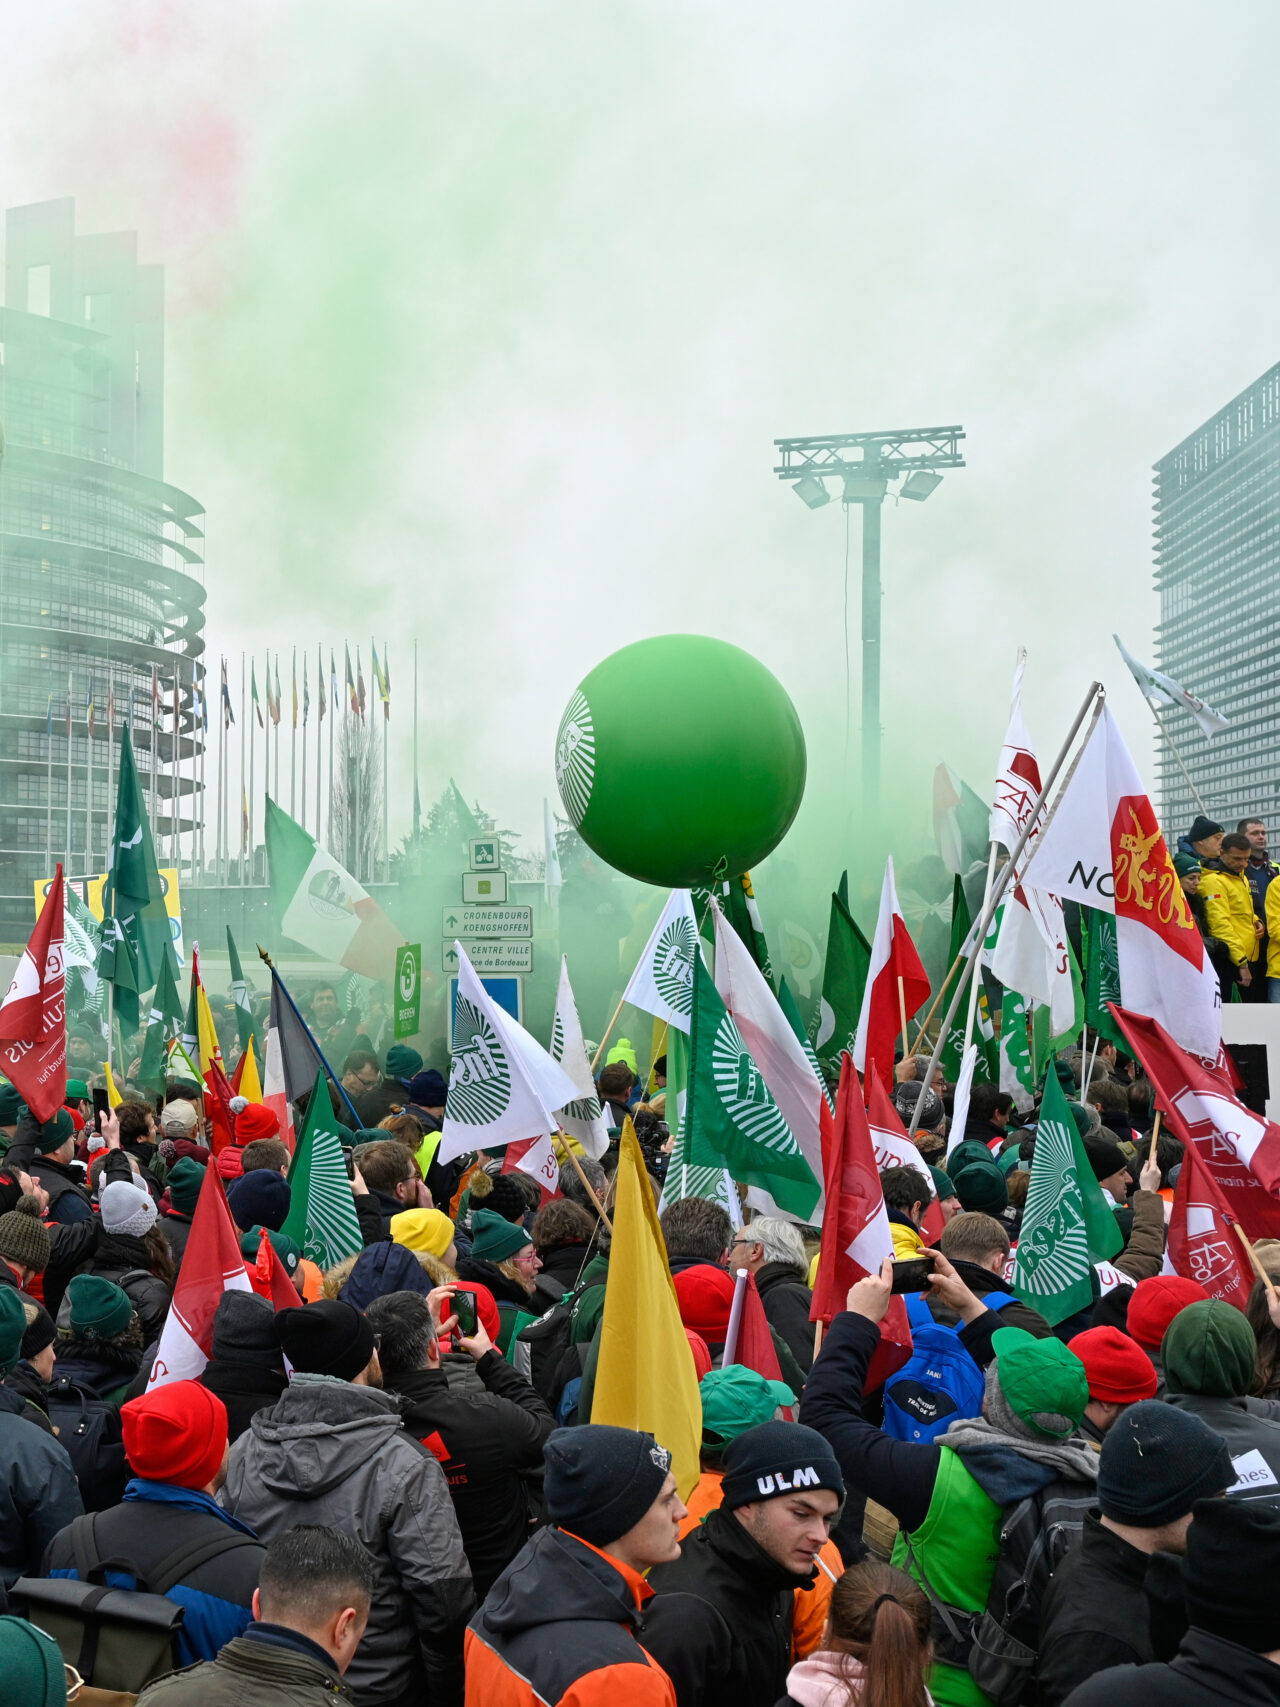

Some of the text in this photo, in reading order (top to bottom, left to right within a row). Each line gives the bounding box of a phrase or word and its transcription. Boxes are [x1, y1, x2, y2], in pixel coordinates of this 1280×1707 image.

[463, 912, 529, 920] CRONENBOURG
[471, 946, 530, 954] CENTRE VILLE
[484, 958, 493, 966] de
[495, 958, 529, 966] Bordeaux
[756, 1466, 821, 1495] ULM
